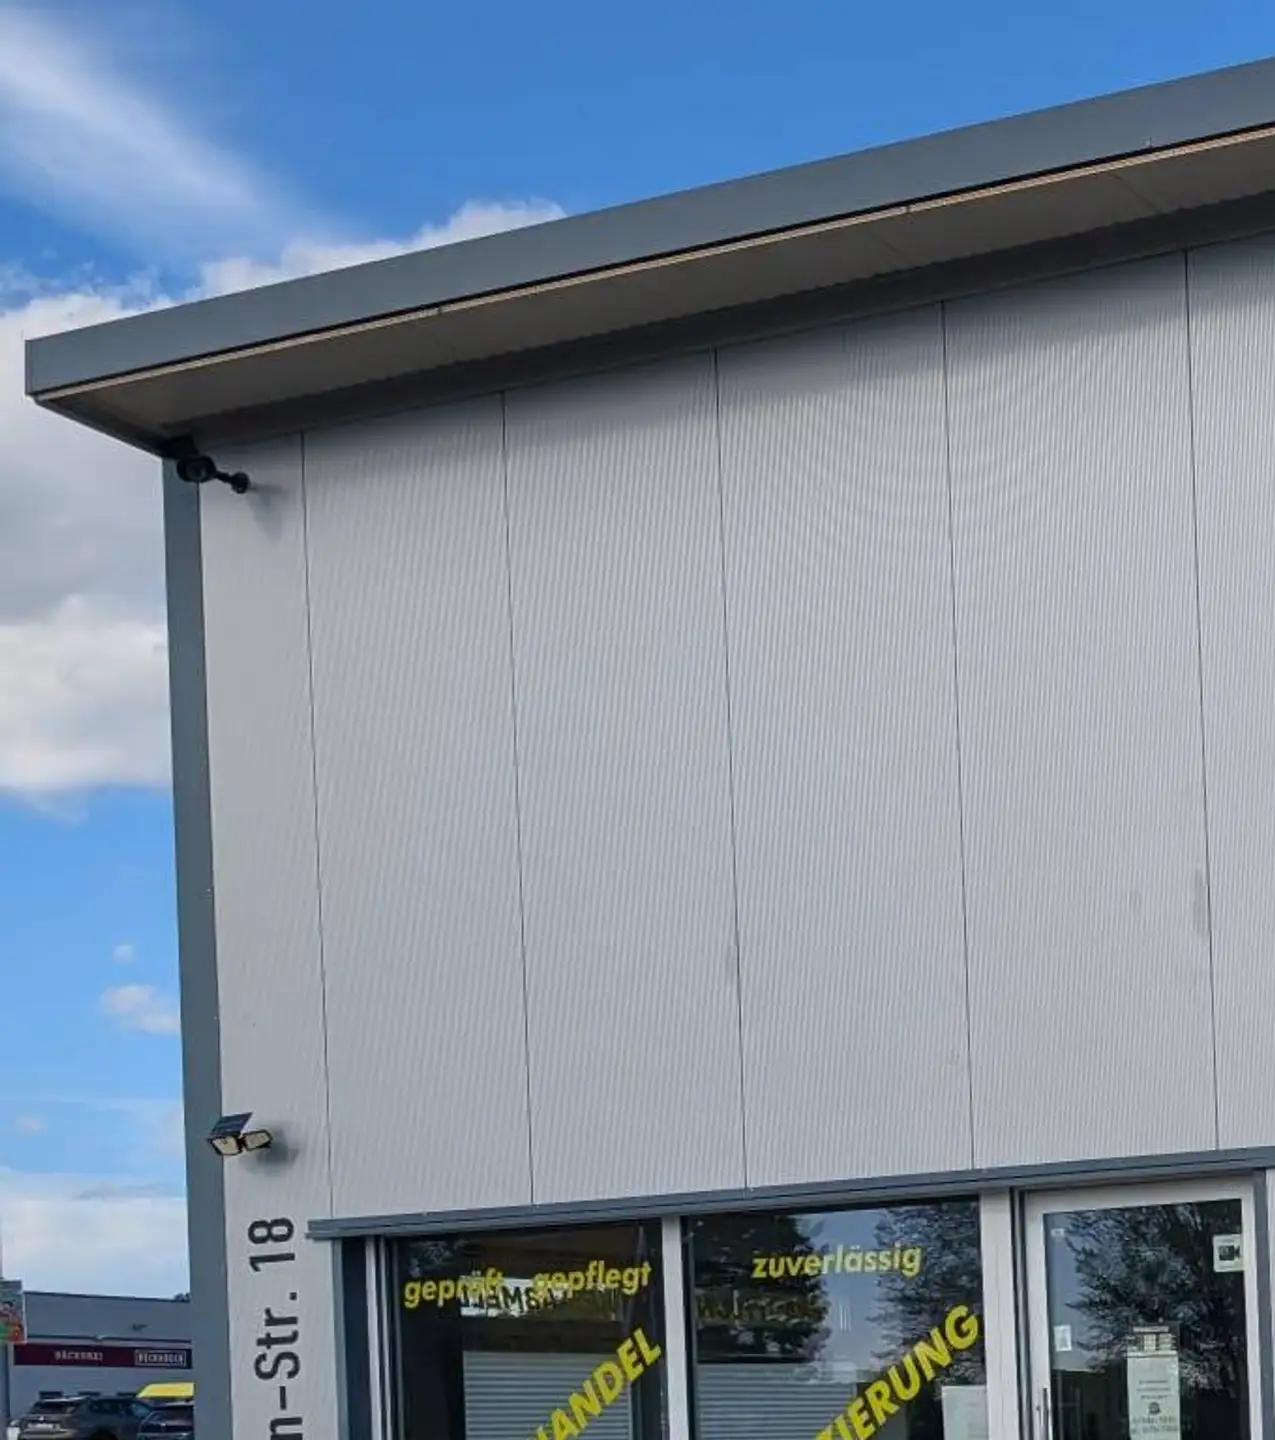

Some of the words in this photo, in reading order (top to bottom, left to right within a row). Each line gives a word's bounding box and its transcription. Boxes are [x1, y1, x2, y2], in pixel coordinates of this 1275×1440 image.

[248, 1216, 296, 1271] 18
[752, 1243, 922, 1277] zuverlässig
[404, 1267, 506, 1308] geprüft
[531, 1260, 652, 1299] gepflegt
